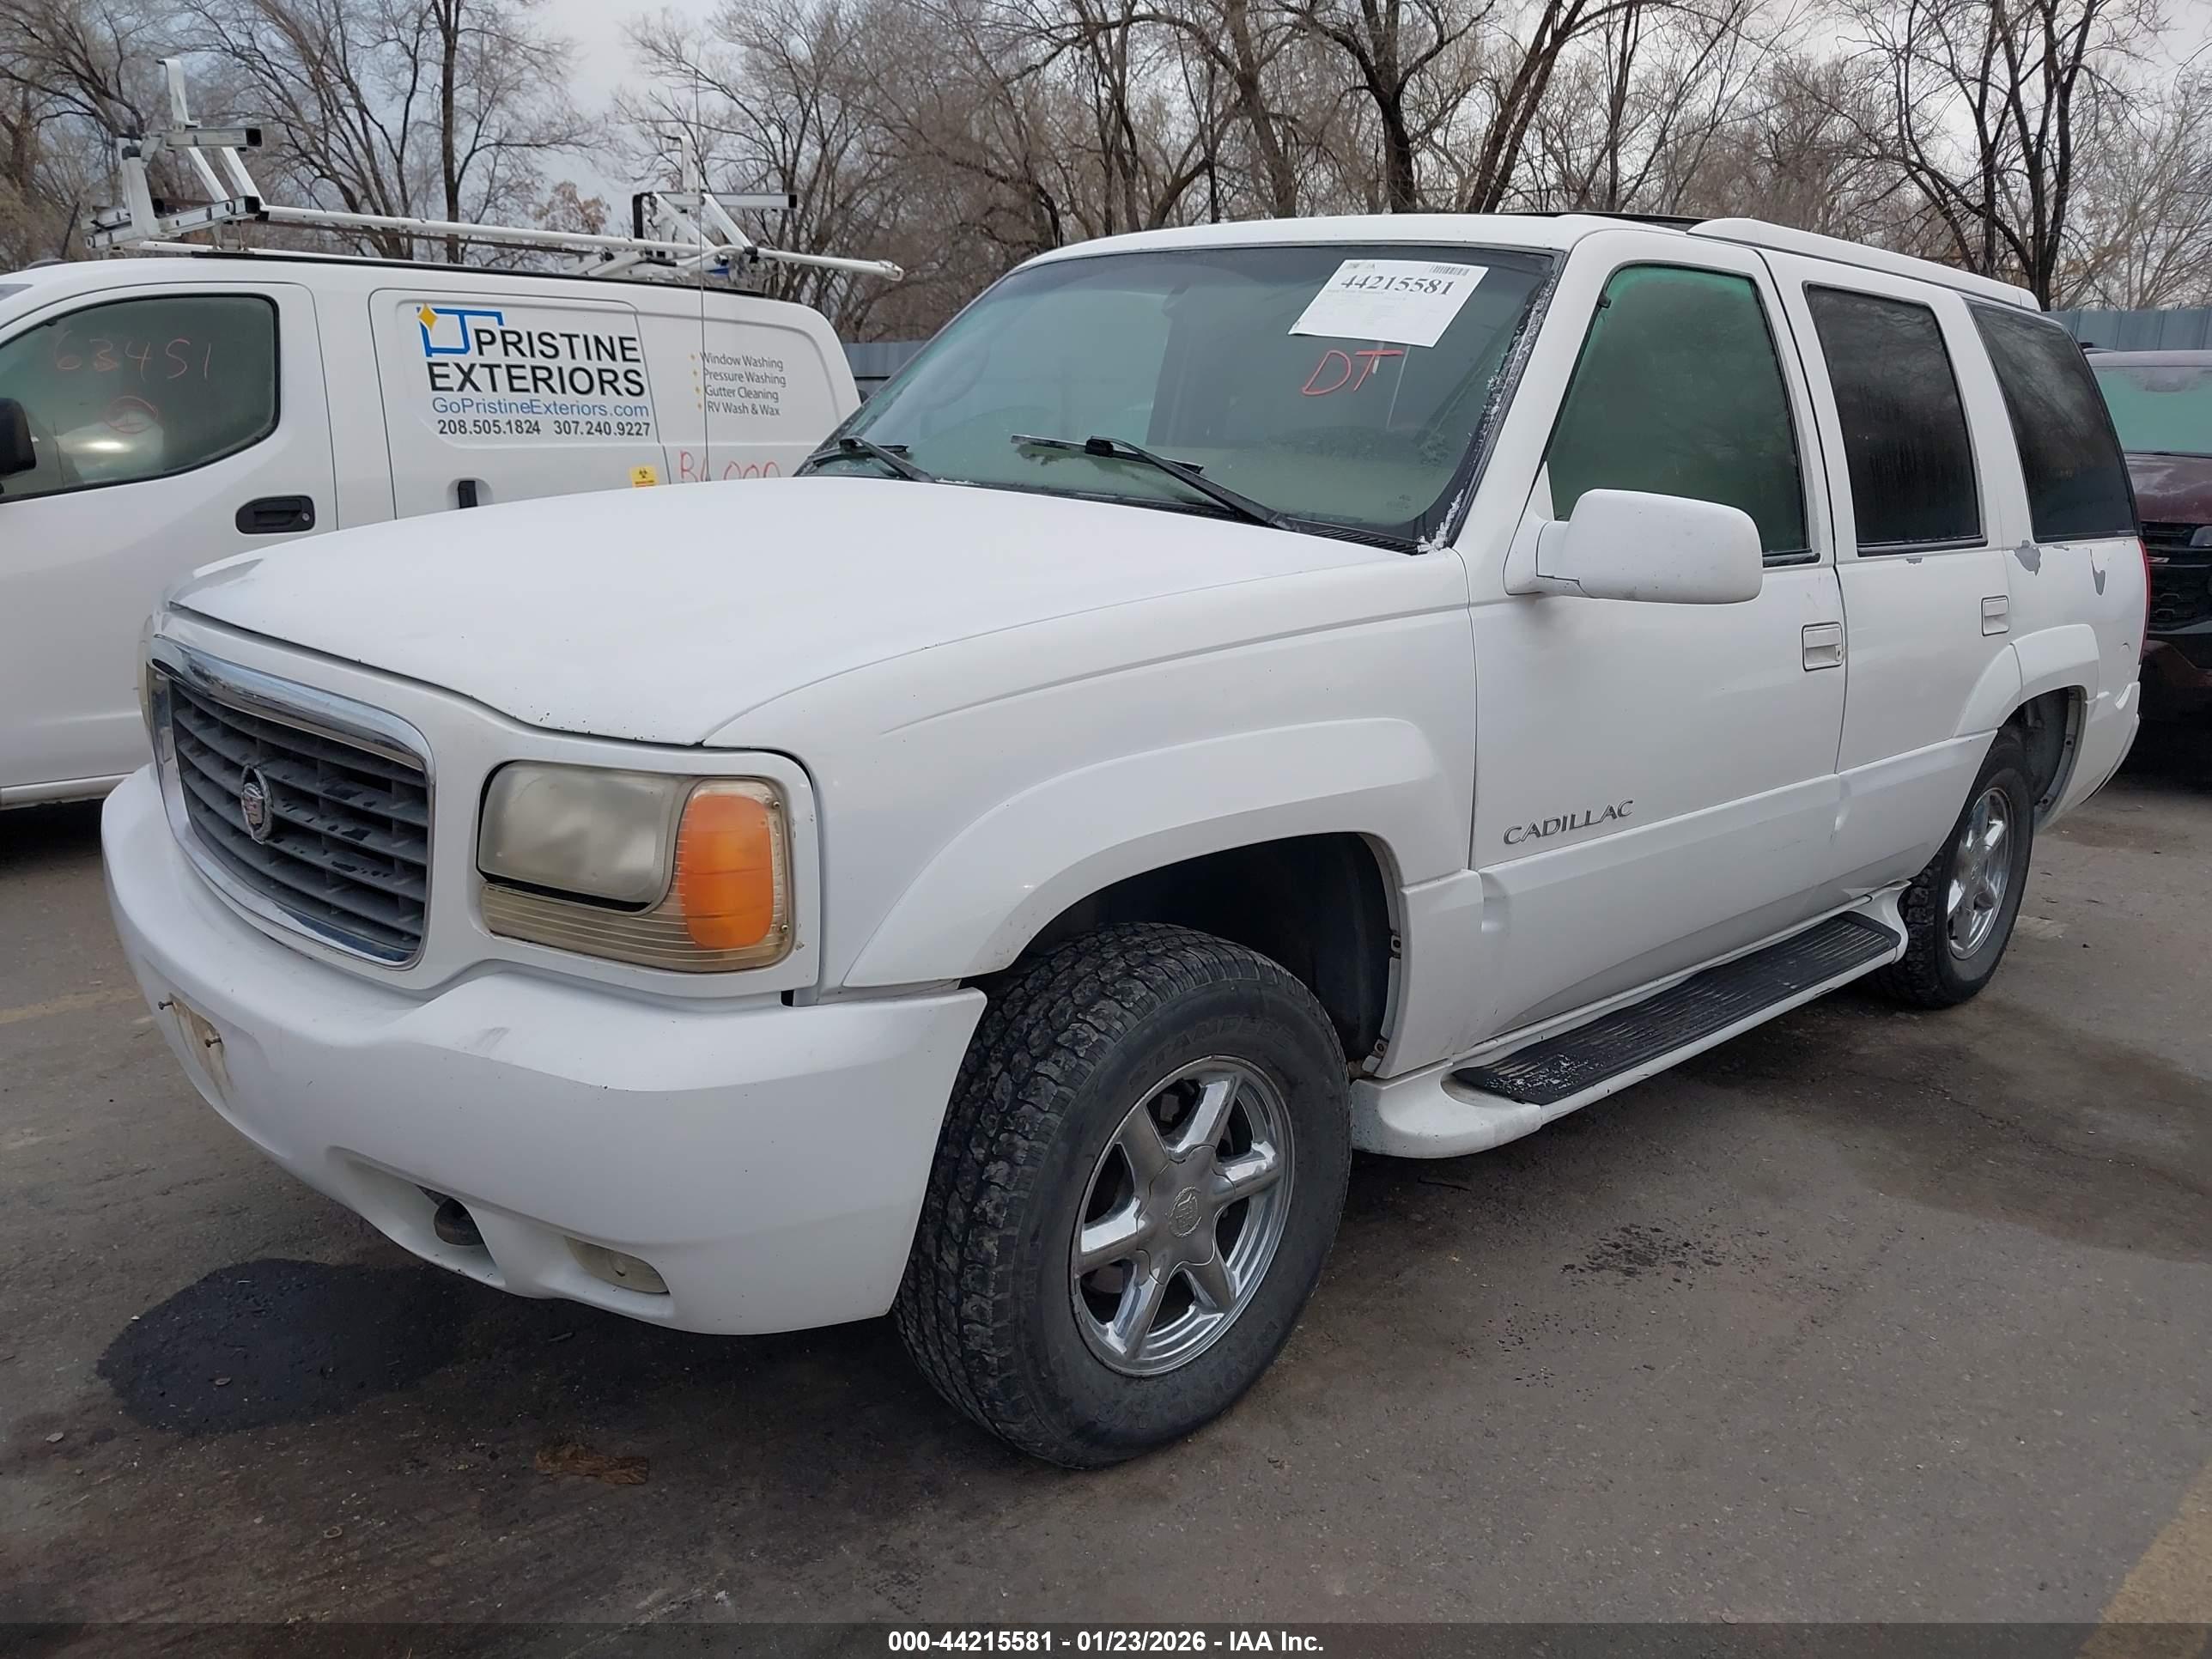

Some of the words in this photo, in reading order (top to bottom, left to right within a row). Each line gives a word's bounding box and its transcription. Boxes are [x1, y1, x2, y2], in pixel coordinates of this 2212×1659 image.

[1340, 274, 1455, 295] 44215581
[473, 328, 641, 363] PRISTINE
[700, 351, 740, 366] Window
[741, 355, 783, 372] Washing
[427, 362, 645, 397] EXTERIORS
[703, 368, 744, 382] Pressure
[744, 371, 786, 388] Washing
[1302, 349, 1403, 396] DT
[705, 385, 736, 398] Gutter
[738, 386, 779, 404] Cleaning
[432, 397, 649, 417] GoPristineExteriors.com
[707, 400, 720, 412] RV
[722, 402, 749, 414] Wash
[750, 404, 758, 415] &
[758, 404, 780, 416] Wax
[438, 419, 541, 435] 208.505.1824
[554, 420, 650, 437] 307.240.9227
[1504, 799, 1633, 845] CADILLAC
[1129, 1014, 1295, 1088] STAMPEDE
